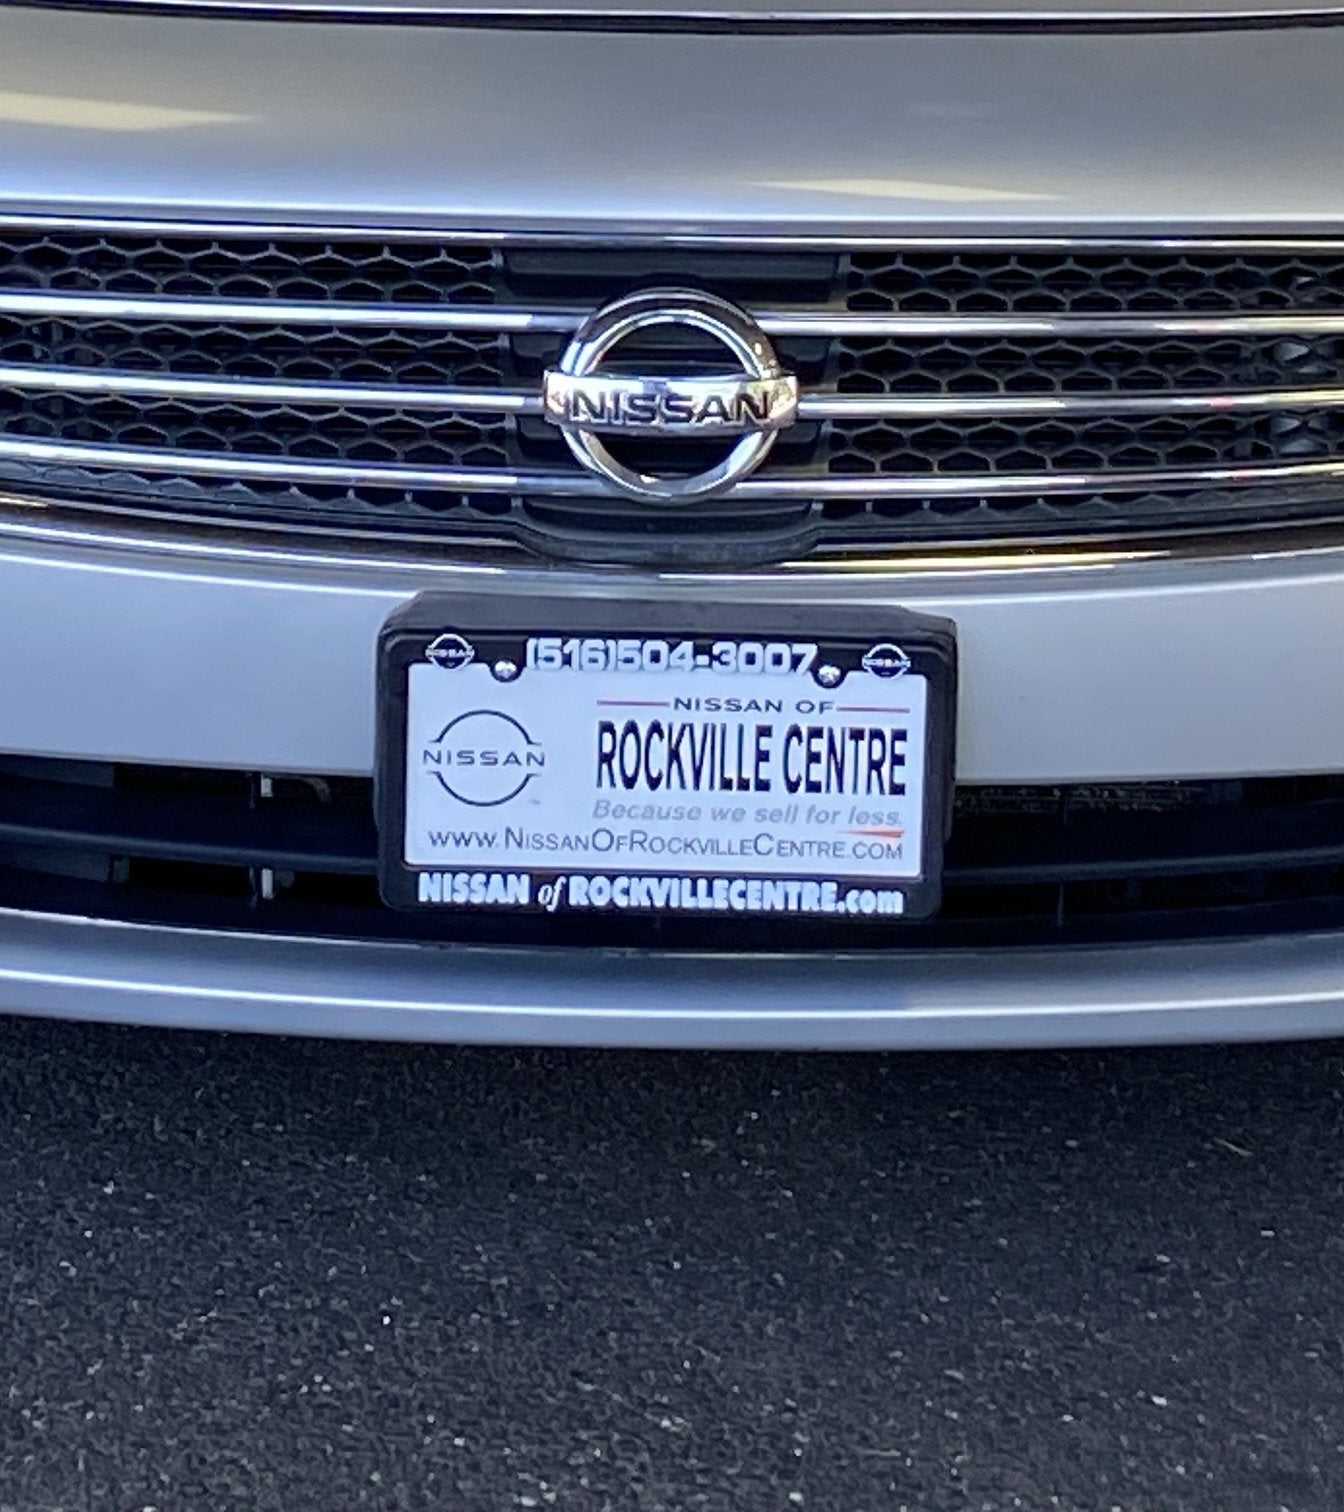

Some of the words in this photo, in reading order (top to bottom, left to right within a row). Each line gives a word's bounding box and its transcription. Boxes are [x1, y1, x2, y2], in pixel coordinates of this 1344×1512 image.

[572, 390, 771, 424] NISSAN
[526, 638, 818, 676] (516)504-3007
[674, 698, 782, 713] NISSAN
[795, 700, 834, 714] OF
[423, 750, 545, 766] NISSAN
[597, 719, 773, 794] ROCKVILLE
[782, 723, 908, 796] CENTRE
[593, 799, 701, 821] Because
[711, 808, 746, 823] we
[755, 804, 798, 824] sell
[807, 805, 840, 825] for
[418, 872, 530, 904] NISSAN
[538, 876, 567, 912] of
[569, 876, 904, 913] ROCKVILLECENTRE.com
